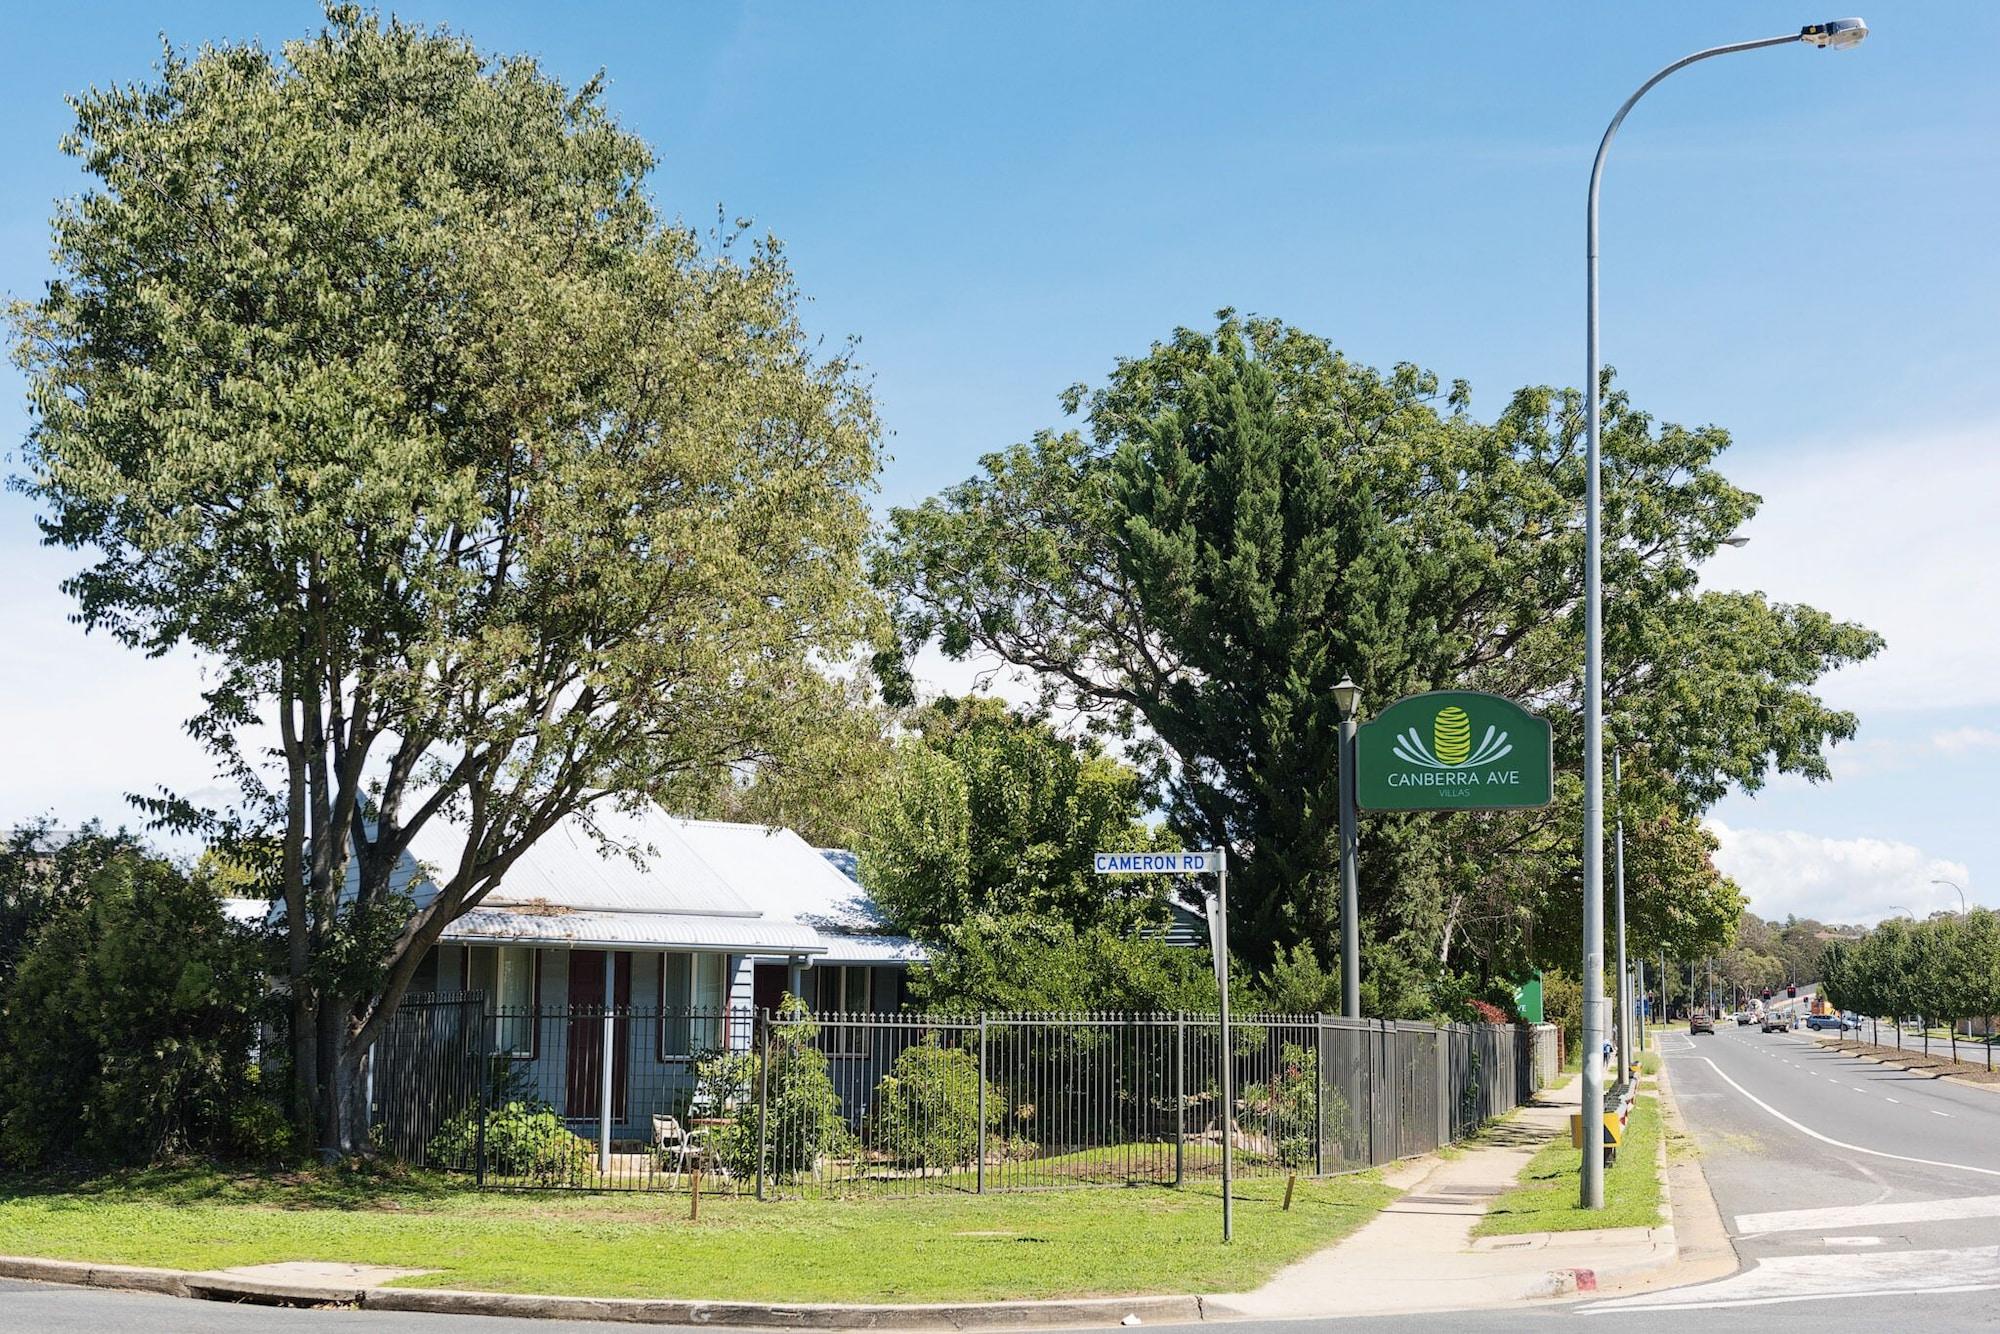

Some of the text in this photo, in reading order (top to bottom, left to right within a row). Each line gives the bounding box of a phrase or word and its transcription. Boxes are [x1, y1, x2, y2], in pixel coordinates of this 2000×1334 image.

[1387, 770, 1520, 787] CANBERRA AVE
[1439, 788, 1471, 798] VILLAS
[1097, 855, 1204, 871] CAMERON RD
